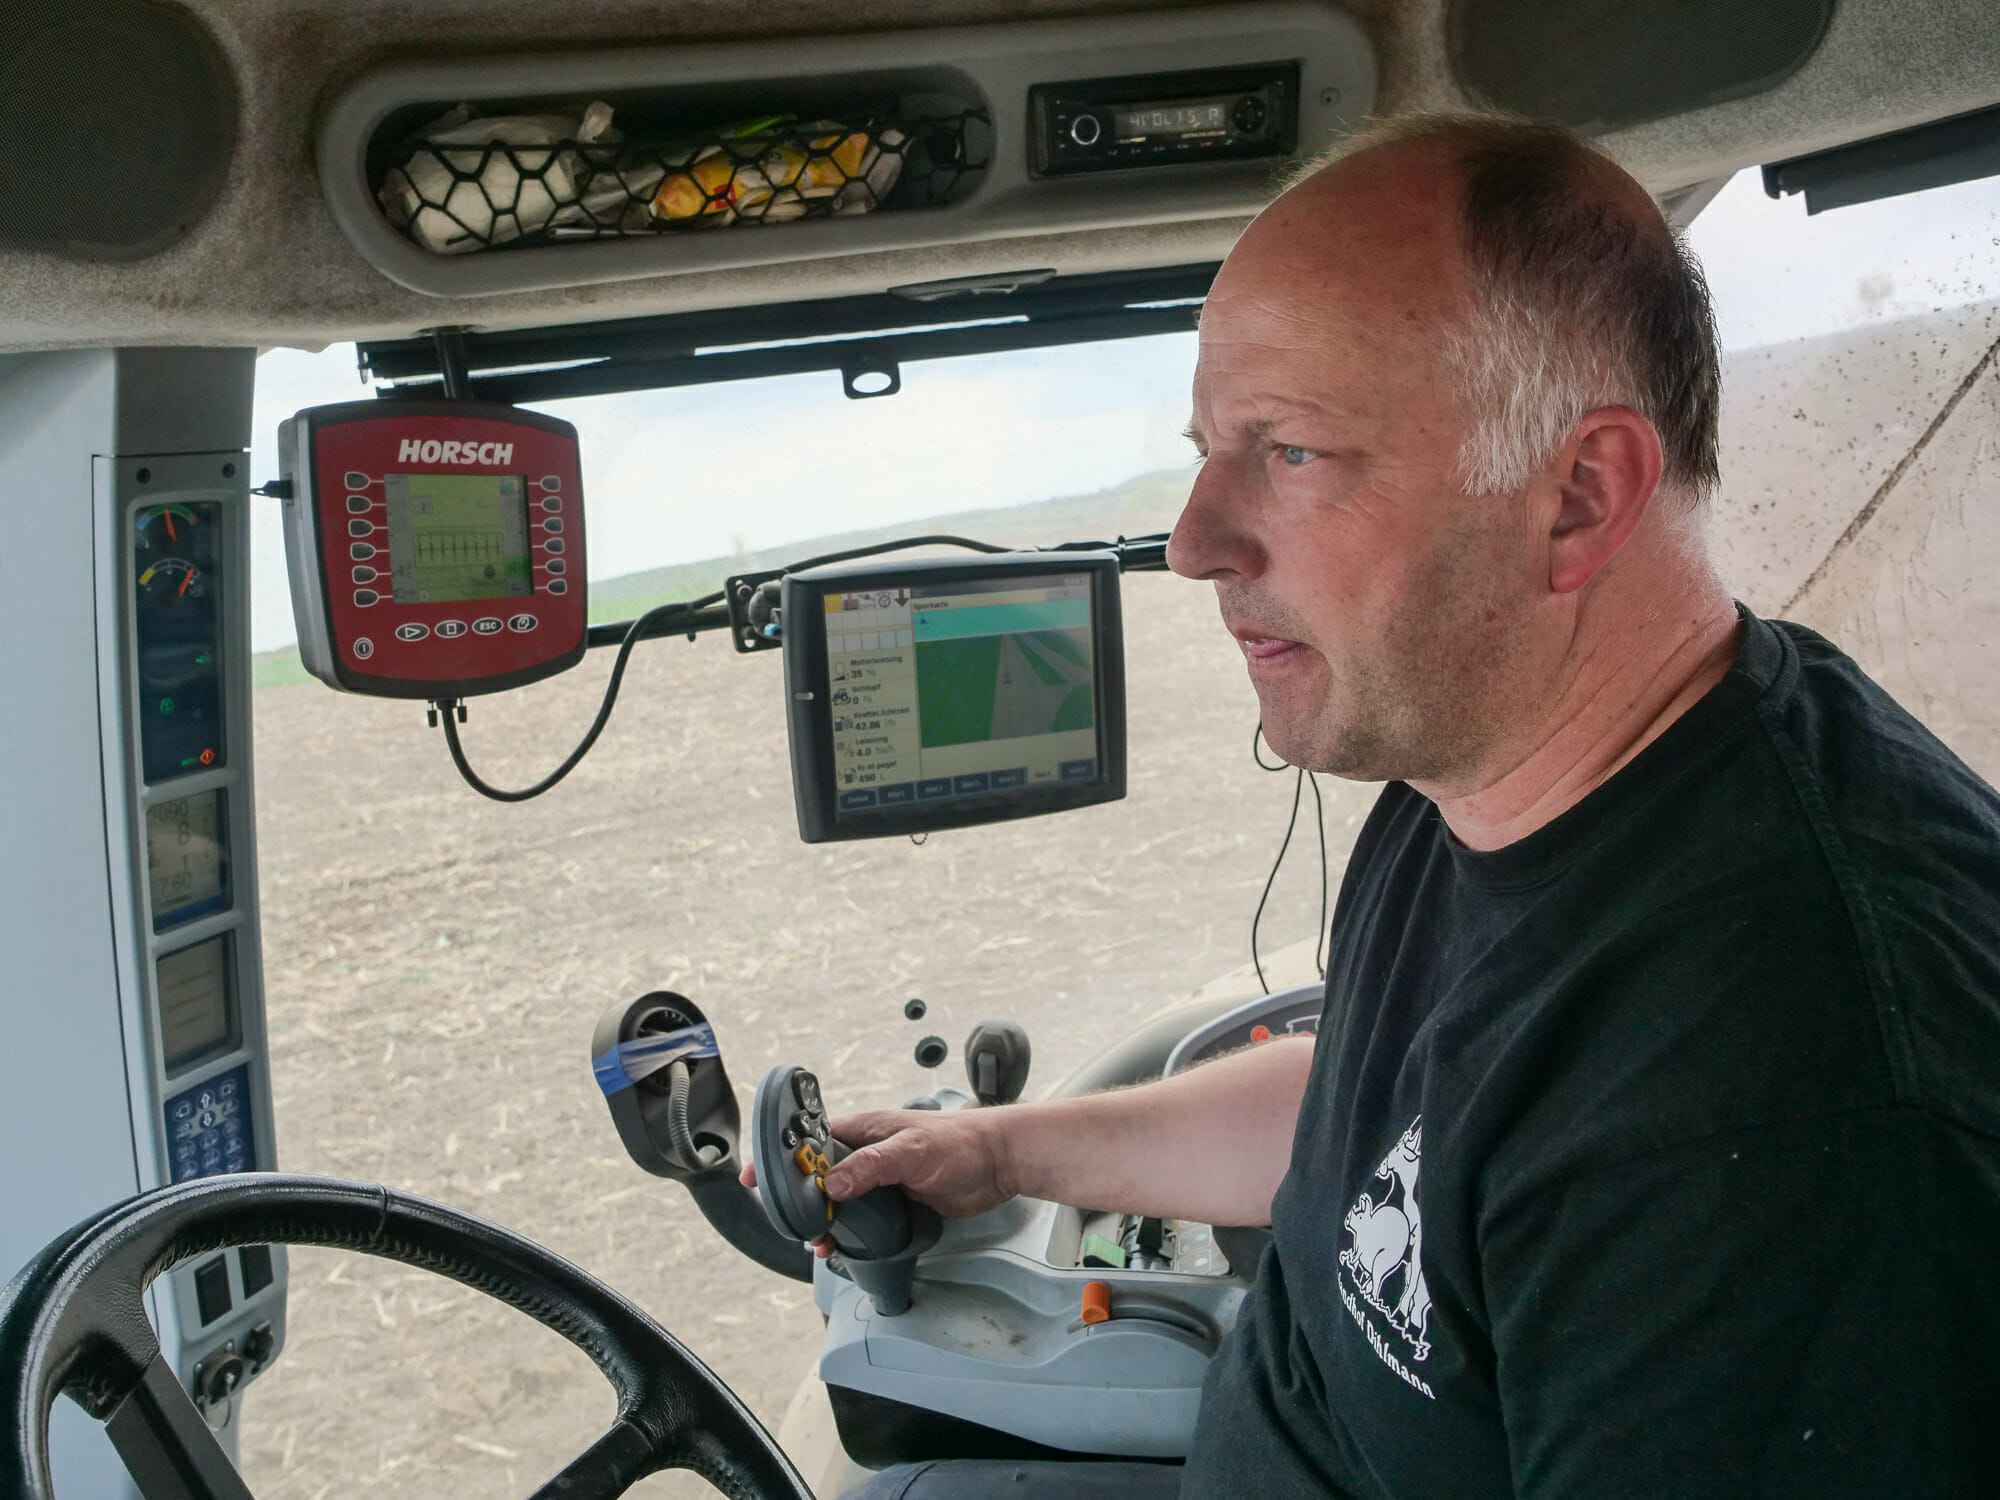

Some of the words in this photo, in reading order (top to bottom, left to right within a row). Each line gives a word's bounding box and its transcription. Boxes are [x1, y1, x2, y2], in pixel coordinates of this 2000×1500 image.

[398, 438, 514, 465] HORSCH
[479, 621, 497, 631] ESC
[850, 669, 863, 679] 35
[1366, 1319, 1437, 1400] Dihlmann
